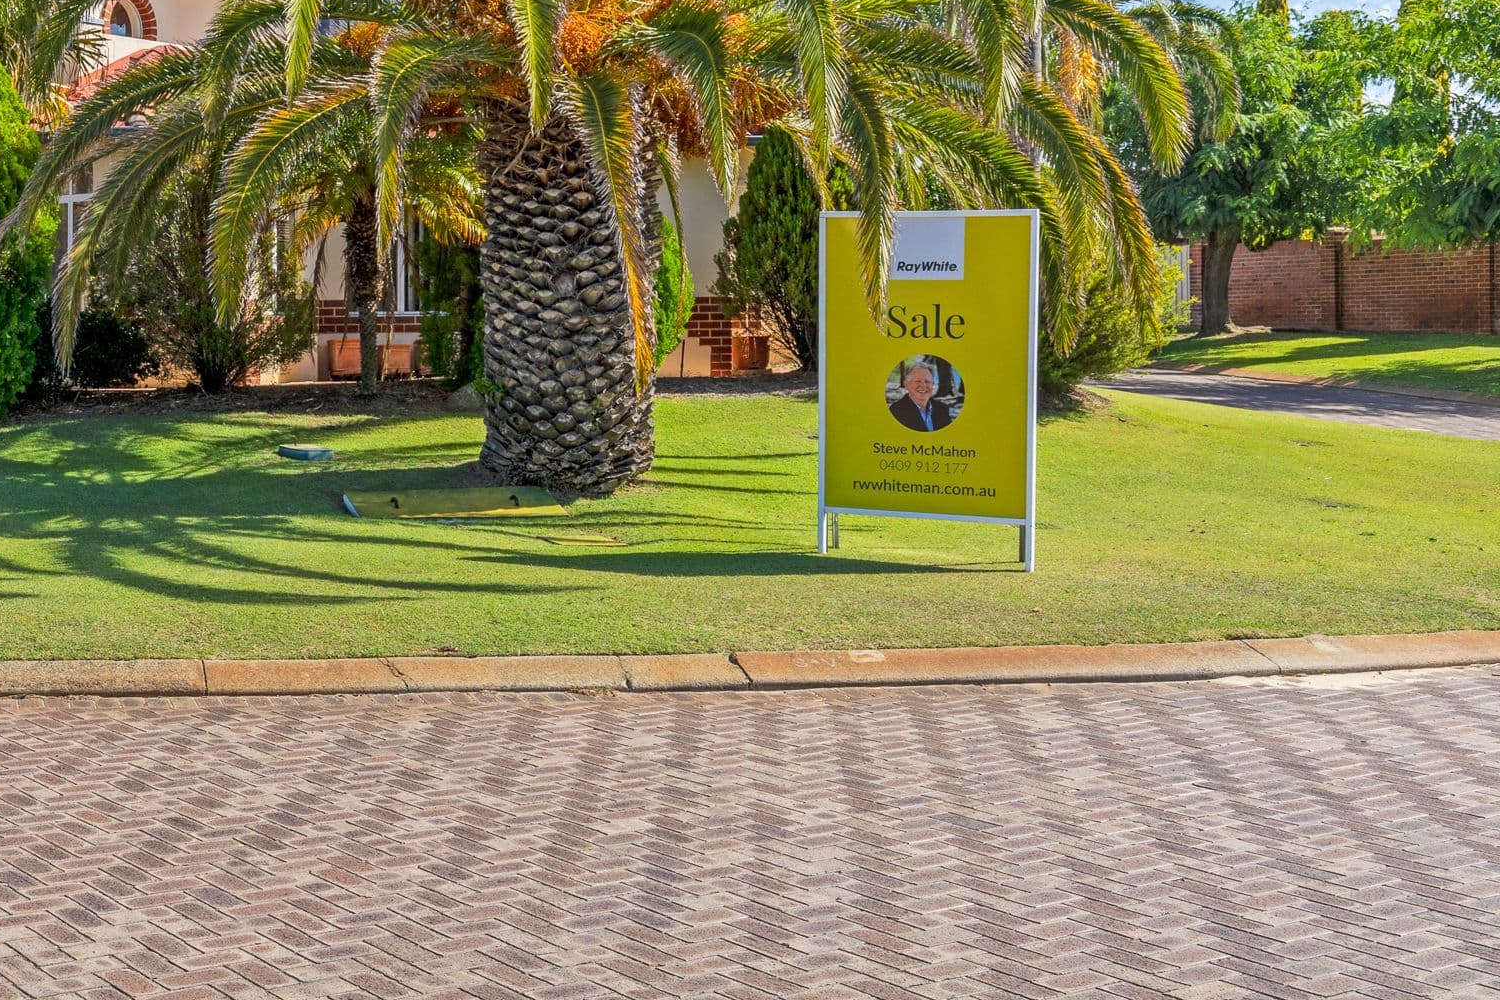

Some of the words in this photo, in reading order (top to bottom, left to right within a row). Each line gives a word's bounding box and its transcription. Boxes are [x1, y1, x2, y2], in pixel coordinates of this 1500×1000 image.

[887, 304, 965, 340] Sale
[873, 442, 908, 455] Steve
[911, 444, 976, 458] McMahon
[879, 459, 912, 472] 0409
[916, 461, 940, 473] 912
[944, 462, 969, 475] 177
[852, 478, 997, 498] rwwhiteman.com.au
